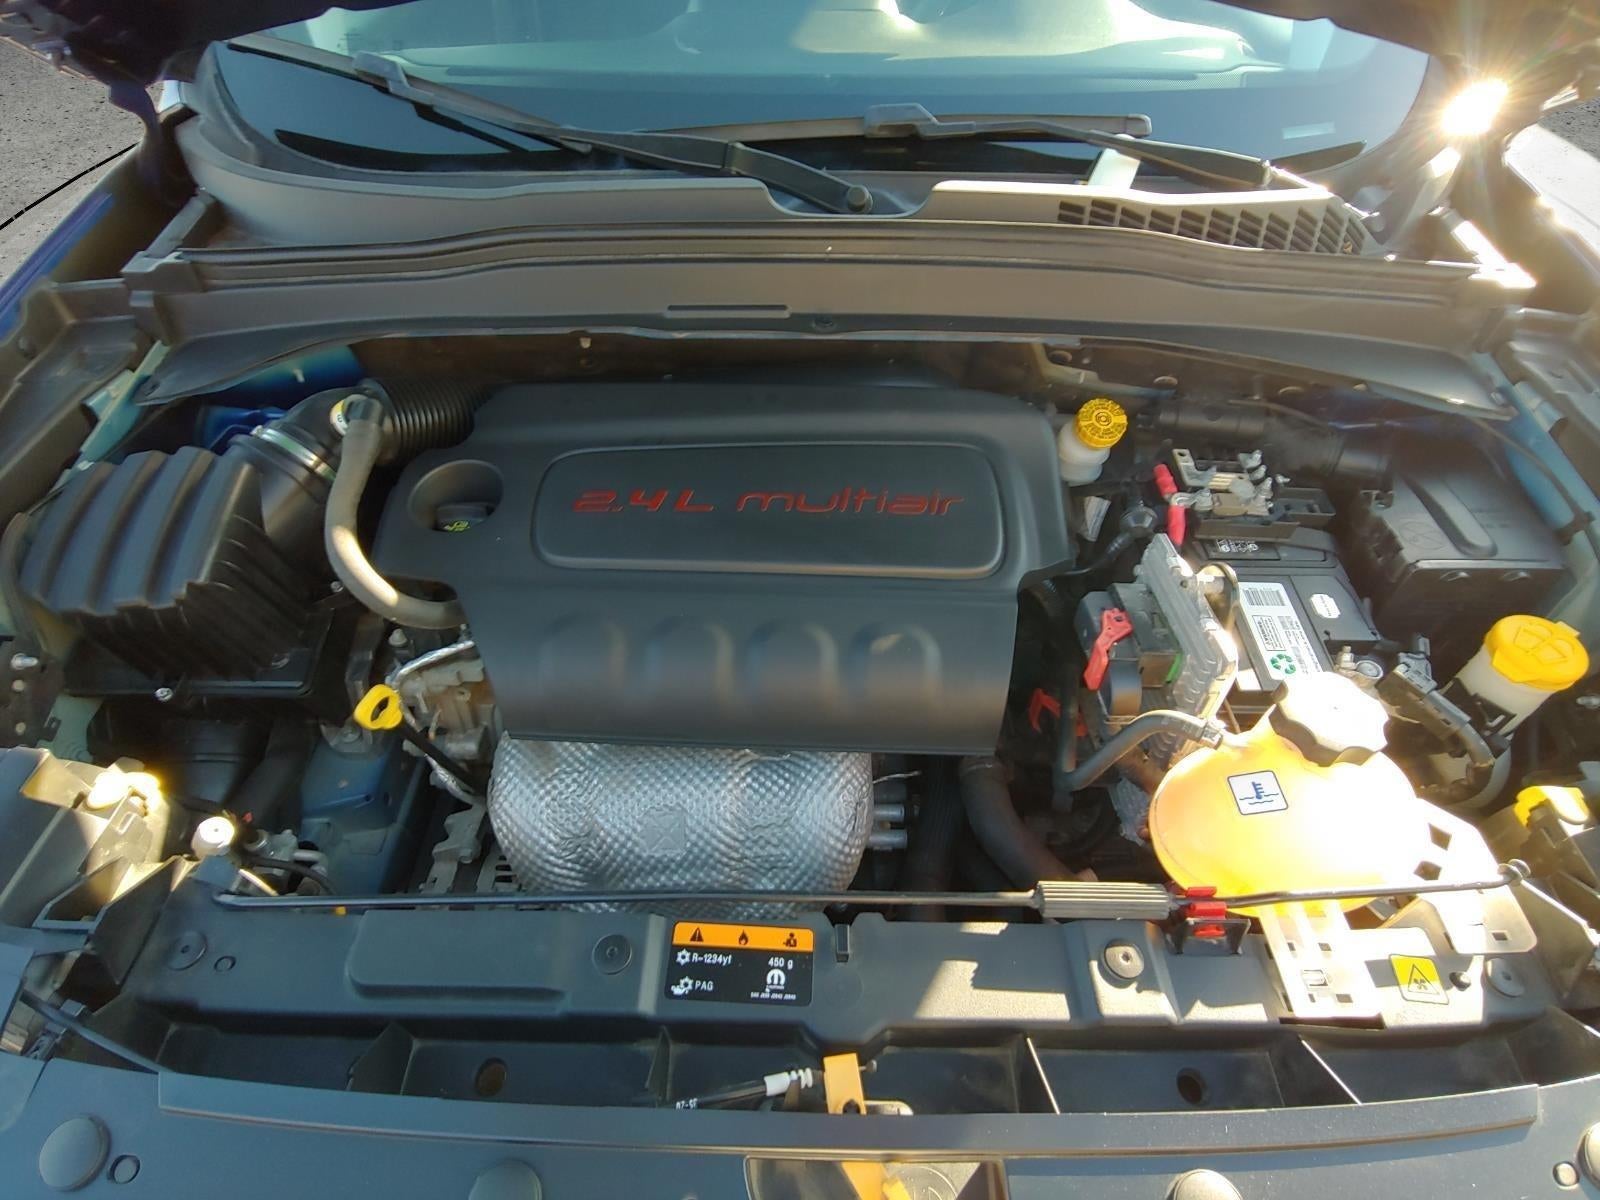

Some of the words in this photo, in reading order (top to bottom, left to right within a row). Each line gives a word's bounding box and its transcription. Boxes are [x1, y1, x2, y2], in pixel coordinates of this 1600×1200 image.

[736, 487, 965, 516] multiair
[692, 952, 733, 967] R-1234yf
[768, 957, 785, 967] 450
[787, 960, 794, 970] g
[694, 981, 714, 991] PAG
